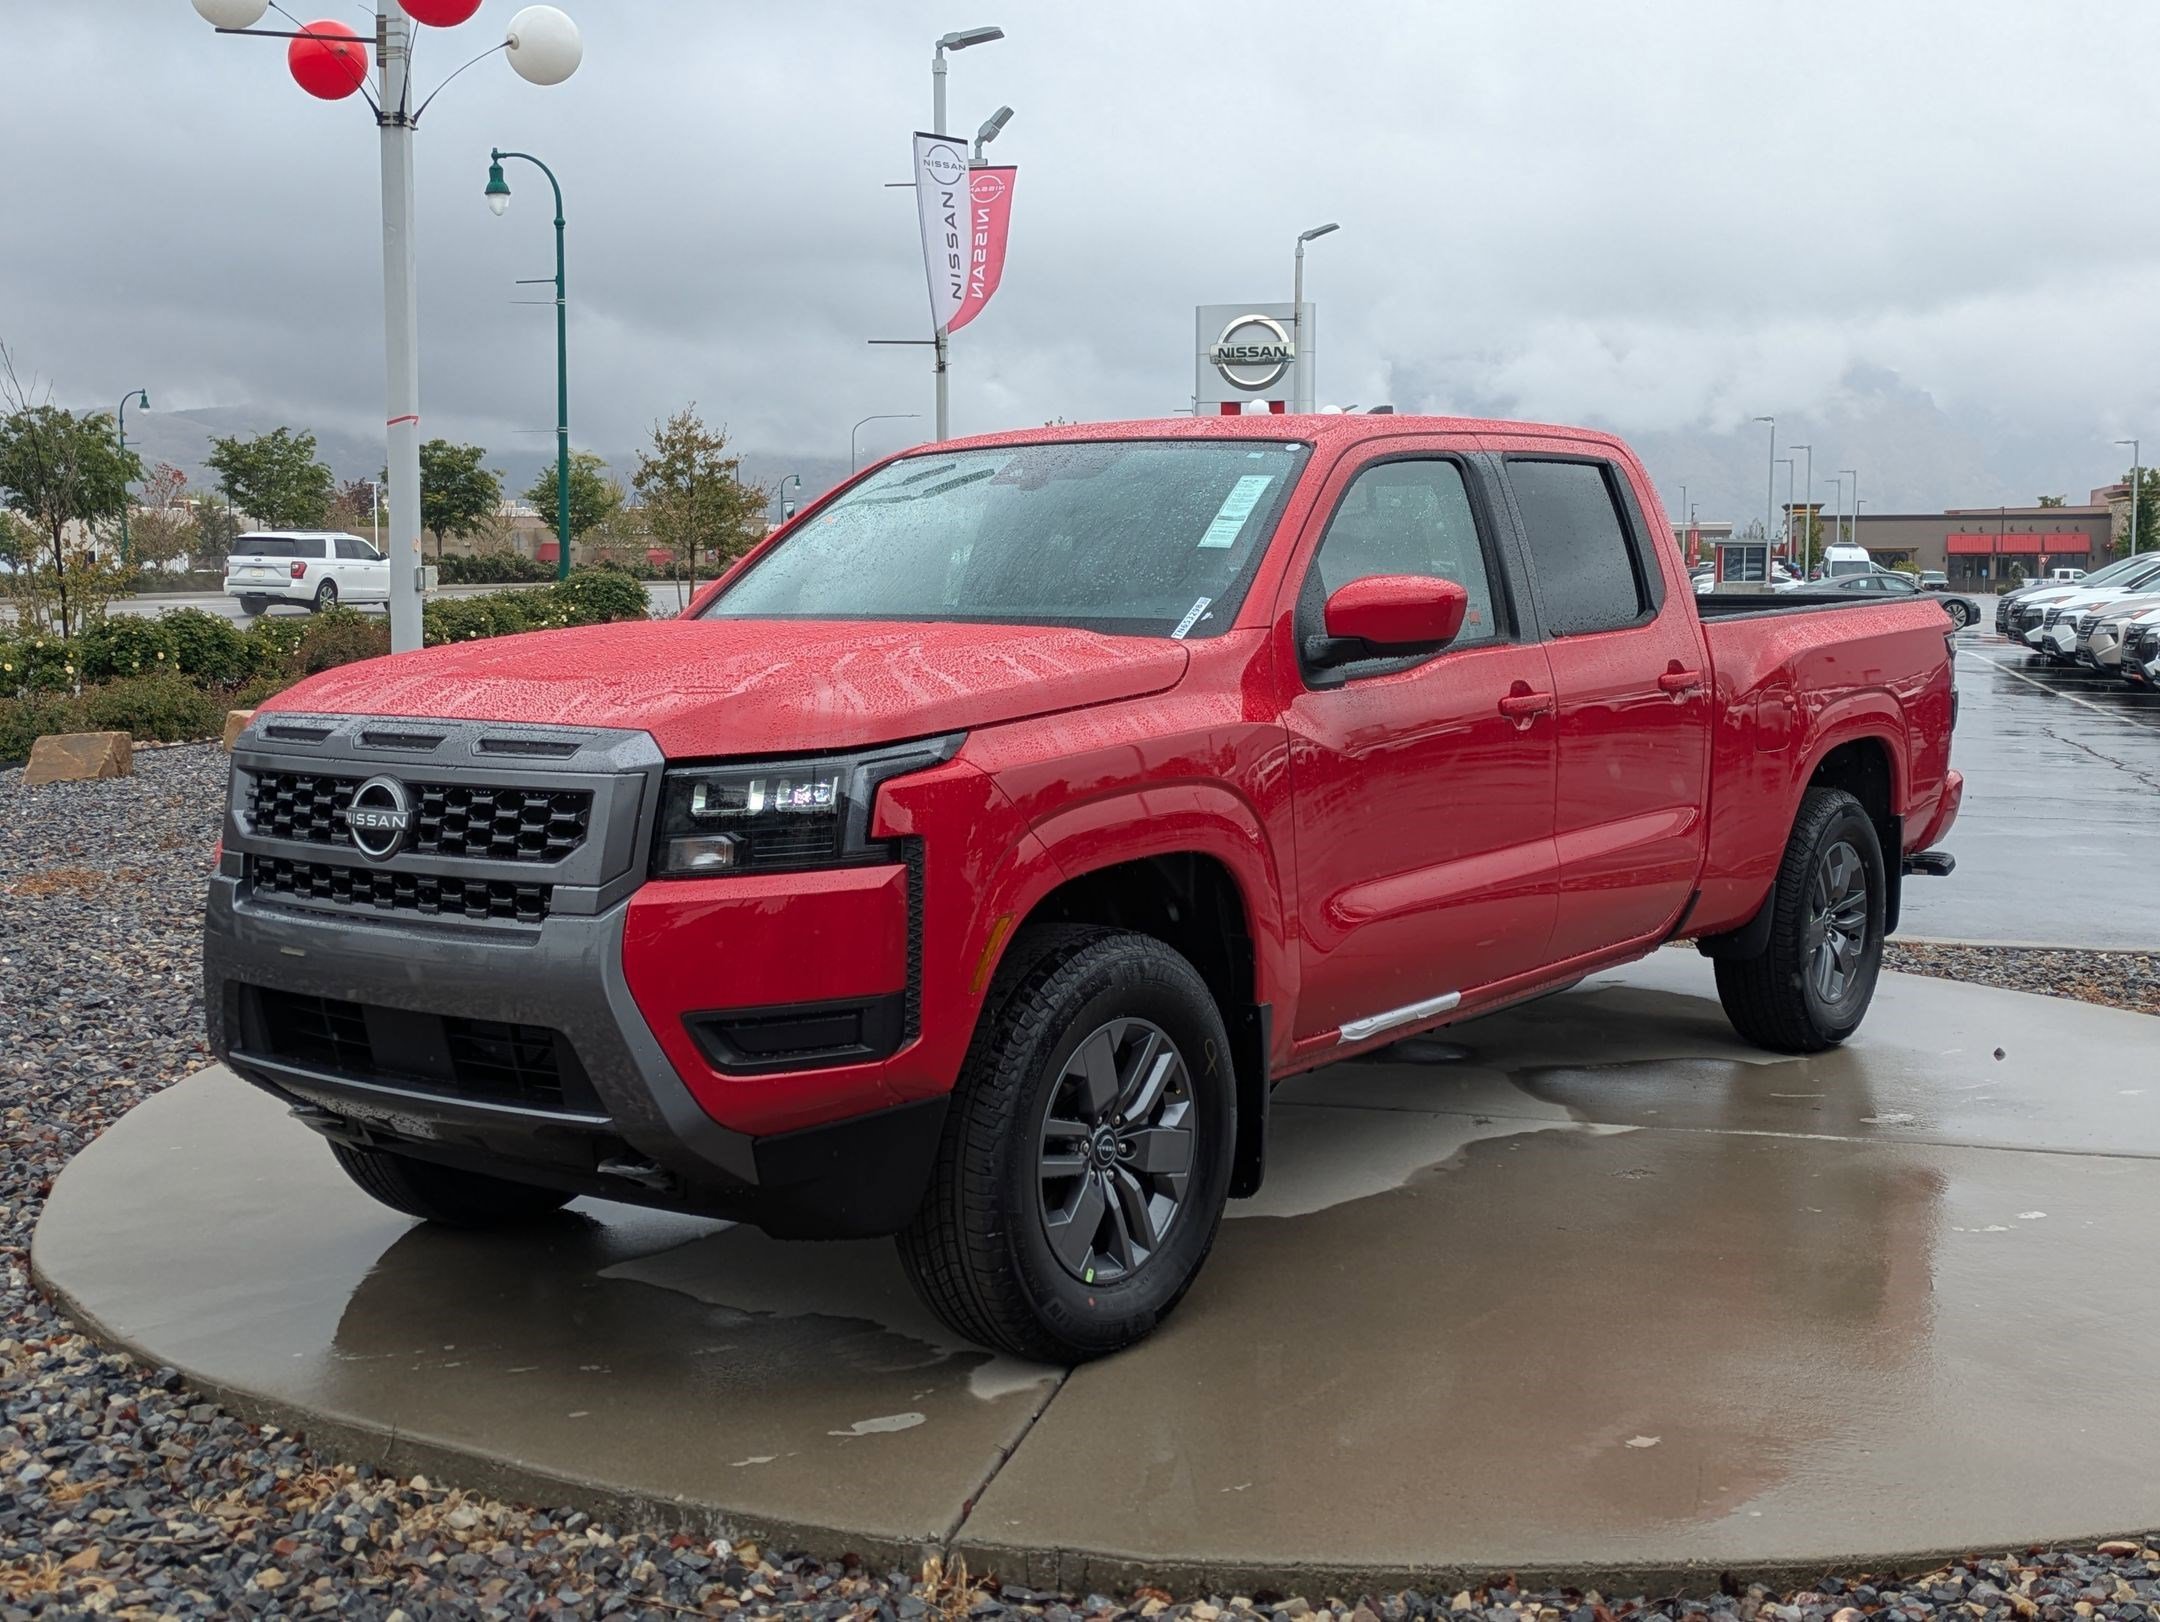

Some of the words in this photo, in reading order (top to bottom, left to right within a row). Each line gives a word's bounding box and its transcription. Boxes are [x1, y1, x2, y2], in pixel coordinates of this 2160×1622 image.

[923, 159, 966, 172] NISSAN
[941, 191, 962, 300] NISSAN
[1218, 345, 1287, 359] NISSAN
[345, 811, 406, 828] NISSAN
